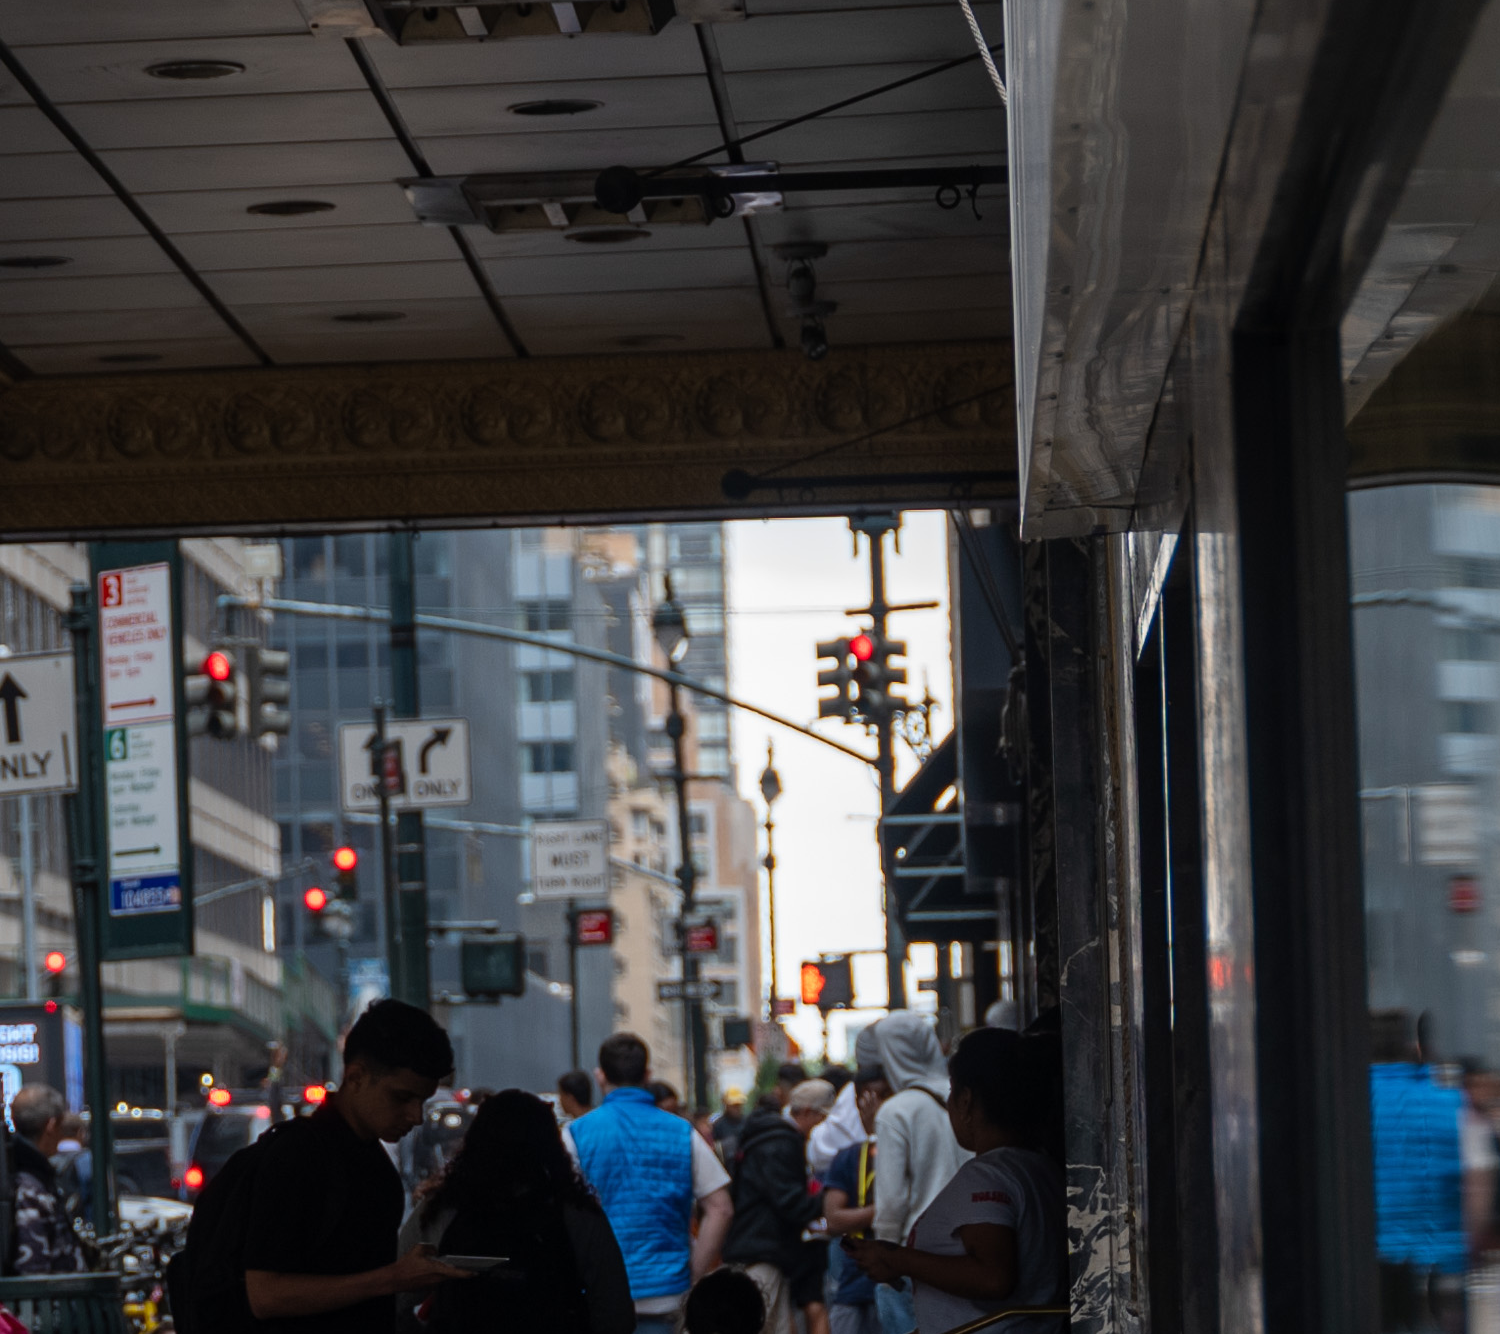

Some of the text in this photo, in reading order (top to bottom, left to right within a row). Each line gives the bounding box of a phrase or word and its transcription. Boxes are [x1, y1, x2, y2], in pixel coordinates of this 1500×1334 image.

[105, 576, 120, 606] 3
[110, 730, 125, 759] 6
[414, 778, 462, 797] ONLY
